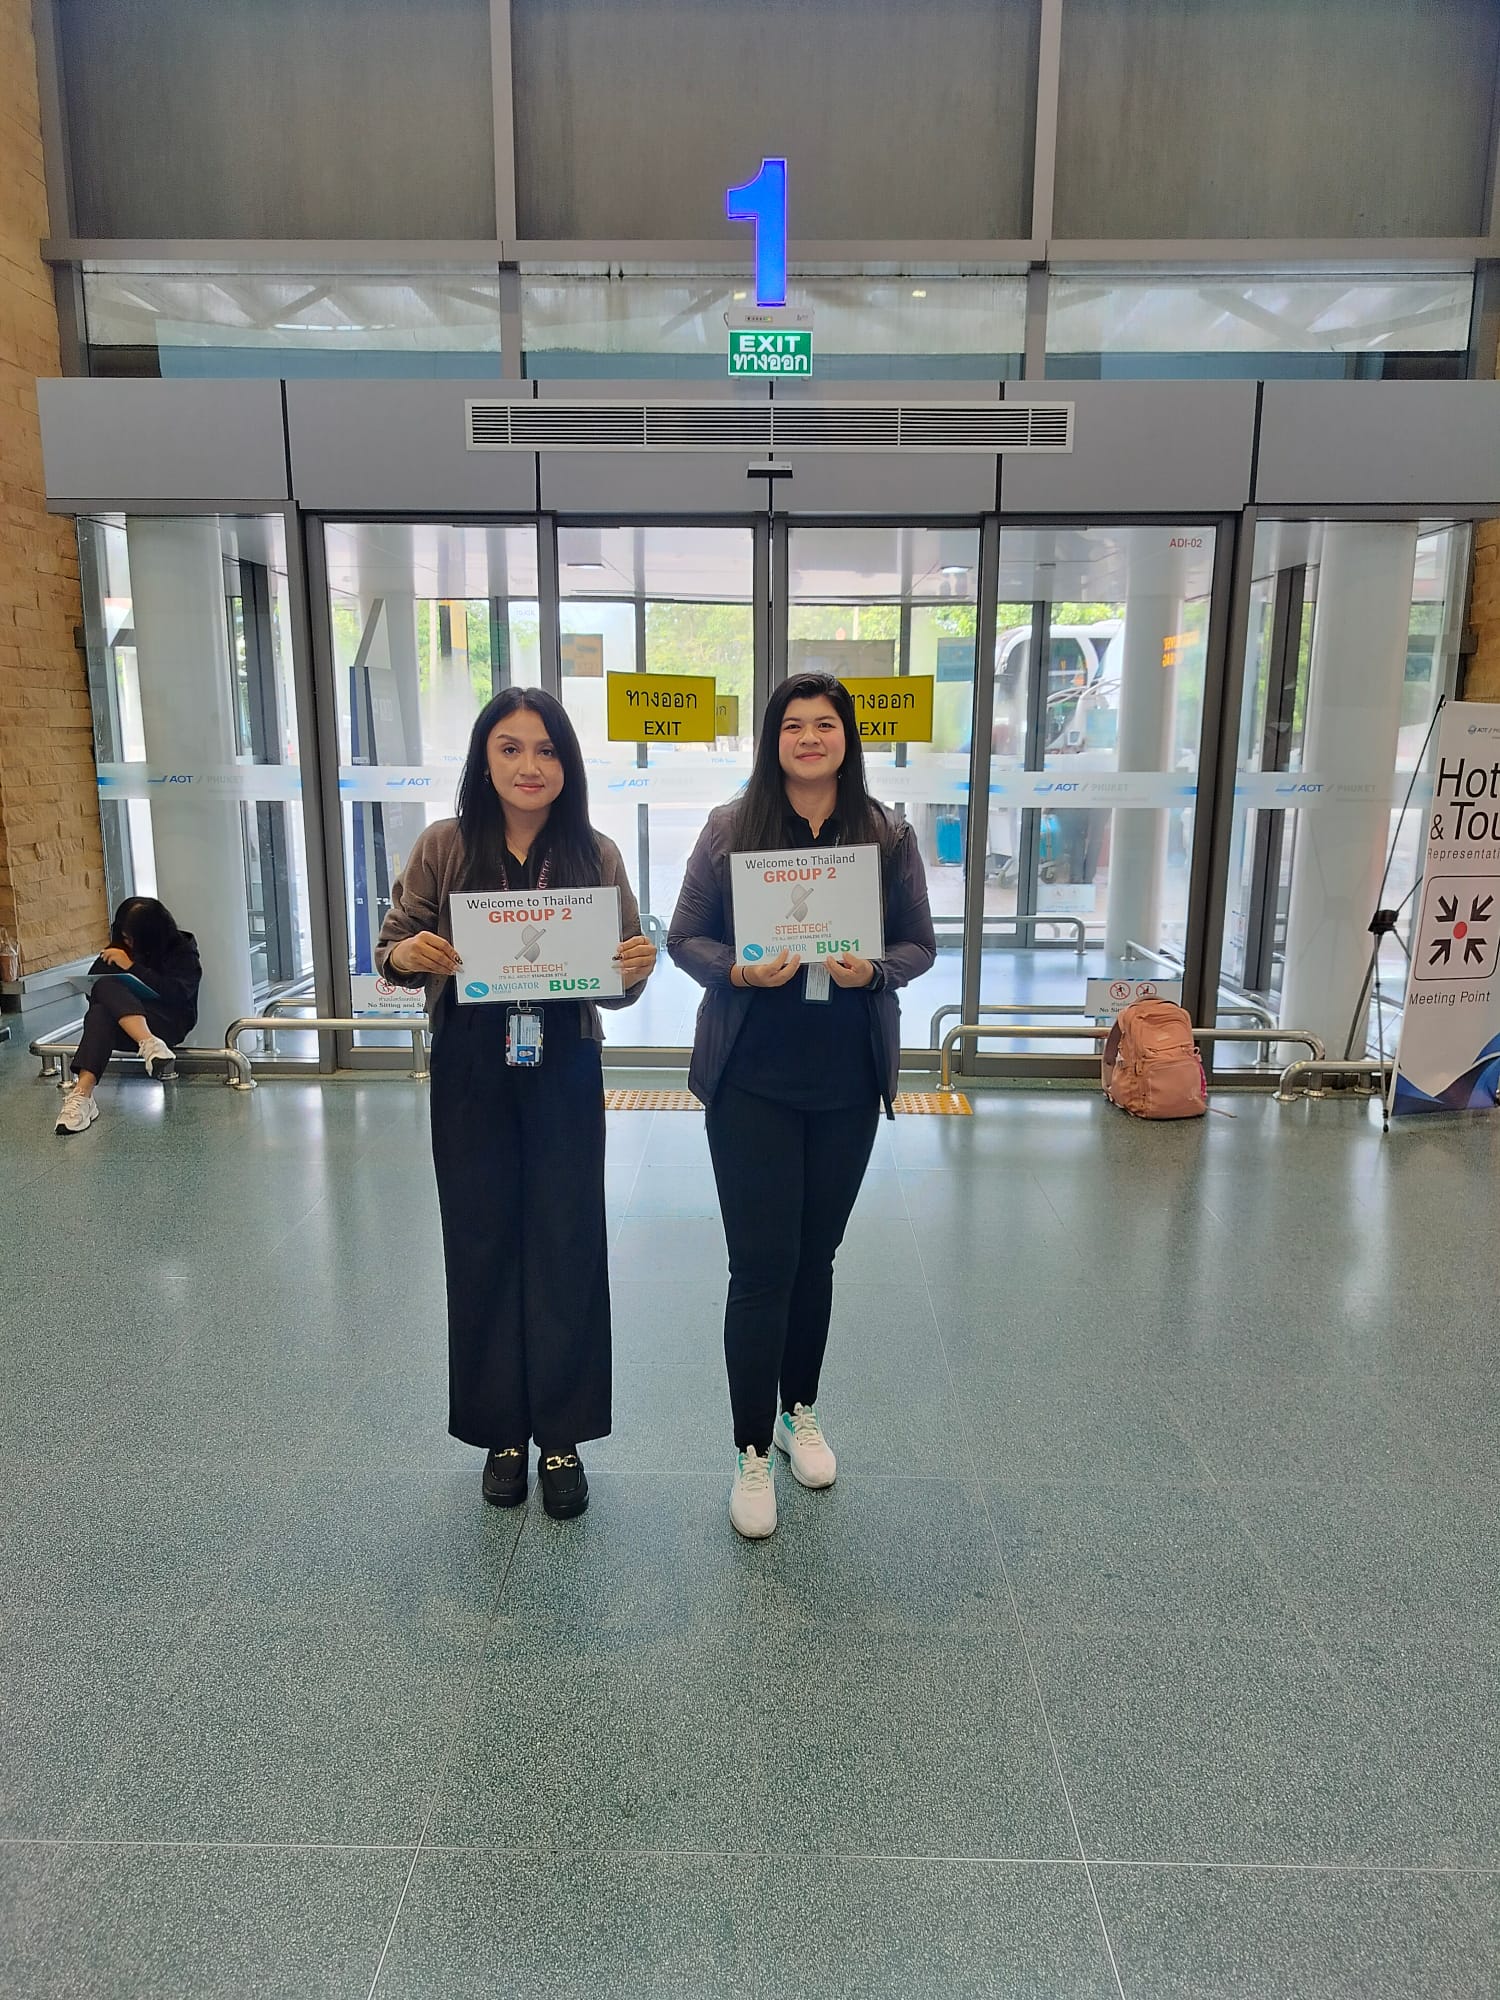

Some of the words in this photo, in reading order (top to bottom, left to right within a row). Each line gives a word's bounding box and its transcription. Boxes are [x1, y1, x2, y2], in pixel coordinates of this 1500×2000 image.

[727, 158, 787, 308] 1
[739, 335, 801, 352] EXIT
[733, 353, 808, 371] ทางออก
[1169, 538, 1202, 548] ADI-02
[626, 689, 697, 709] ทางออก
[644, 720, 682, 736] EXIT
[860, 721, 899, 736] EXIT
[169, 775, 194, 784] AOT
[407, 778, 431, 786] AOT
[628, 778, 650, 787] AOT
[1054, 783, 1079, 792] AOT
[1297, 784, 1324, 793] AOT
[1430, 814, 1444, 840] &
[745, 859, 794, 870] Welcome
[797, 857, 808, 866] to
[811, 853, 856, 865] Thailand
[763, 868, 822, 883] GROUP
[827, 867, 837, 879] 2
[467, 898, 524, 910] Welcome
[527, 897, 539, 907] to
[542, 894, 593, 906] Thailand
[488, 908, 555, 924] GROUP
[561, 907, 573, 921] 2
[816, 938, 860, 954] BUS1
[491, 981, 539, 991] NAVIGATOR
[549, 977, 600, 992] BUS2
[1409, 992, 1455, 1006] Meeting
[1460, 991, 1490, 1003] Point
